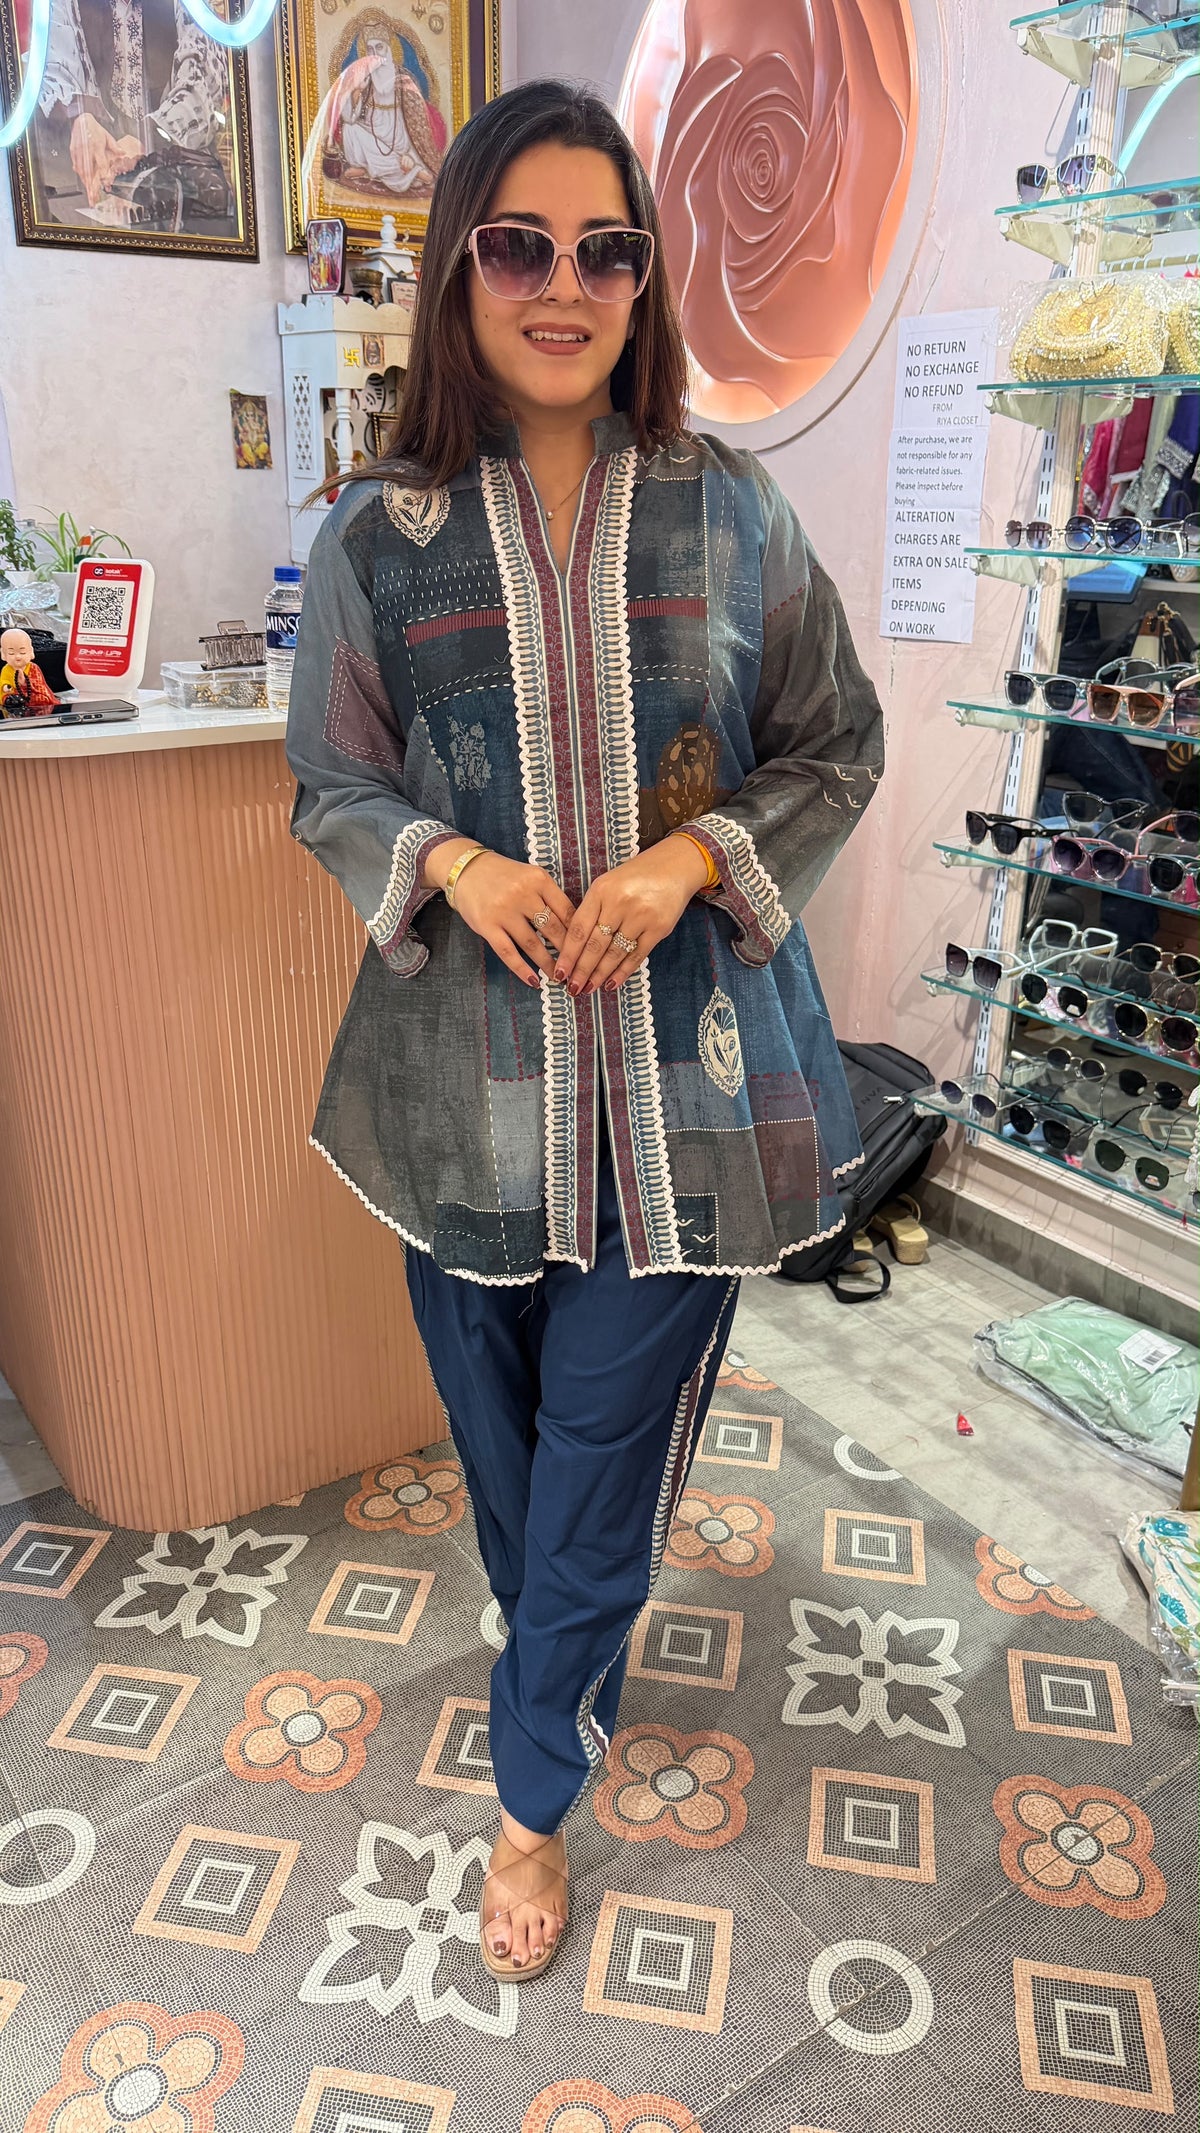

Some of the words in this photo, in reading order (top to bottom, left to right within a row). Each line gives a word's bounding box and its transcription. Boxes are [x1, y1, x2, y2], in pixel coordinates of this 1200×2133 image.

[906, 344, 922, 357] NO
[924, 340, 967, 356] RETURN
[905, 365, 921, 378] NO
[923, 361, 980, 376] EXCHANGE
[904, 386, 919, 398] NO
[922, 383, 964, 398] REFUND
[932, 403, 953, 413] FROM
[936, 416, 951, 425] RIYA
[952, 415, 979, 425] CLOSET
[897, 436, 913, 444] After
[914, 435, 947, 445] purchase,
[949, 436, 960, 444] we
[961, 436, 973, 444] are
[896, 452, 907, 460] not
[908, 451, 947, 461] responsible
[948, 450, 958, 459] for
[960, 451, 973, 461] any
[896, 466, 940, 475] fabric-related
[940, 466, 963, 475] issues.
[895, 481, 916, 490] Please
[917, 481, 940, 492] inspect
[941, 481, 964, 491] before
[894, 497, 915, 506] buying
[895, 511, 955, 523] ALTERATION
[894, 533, 938, 545] CHARGES
[940, 534, 961, 546] ARE
[893, 555, 923, 568] EXTRA
[925, 556, 942, 568] ON
[945, 557, 969, 569] SALE
[892, 577, 922, 590] ITEMS
[891, 599, 946, 614] DEPENDING
[889, 621, 903, 633] ON
[905, 622, 936, 635] WORK
